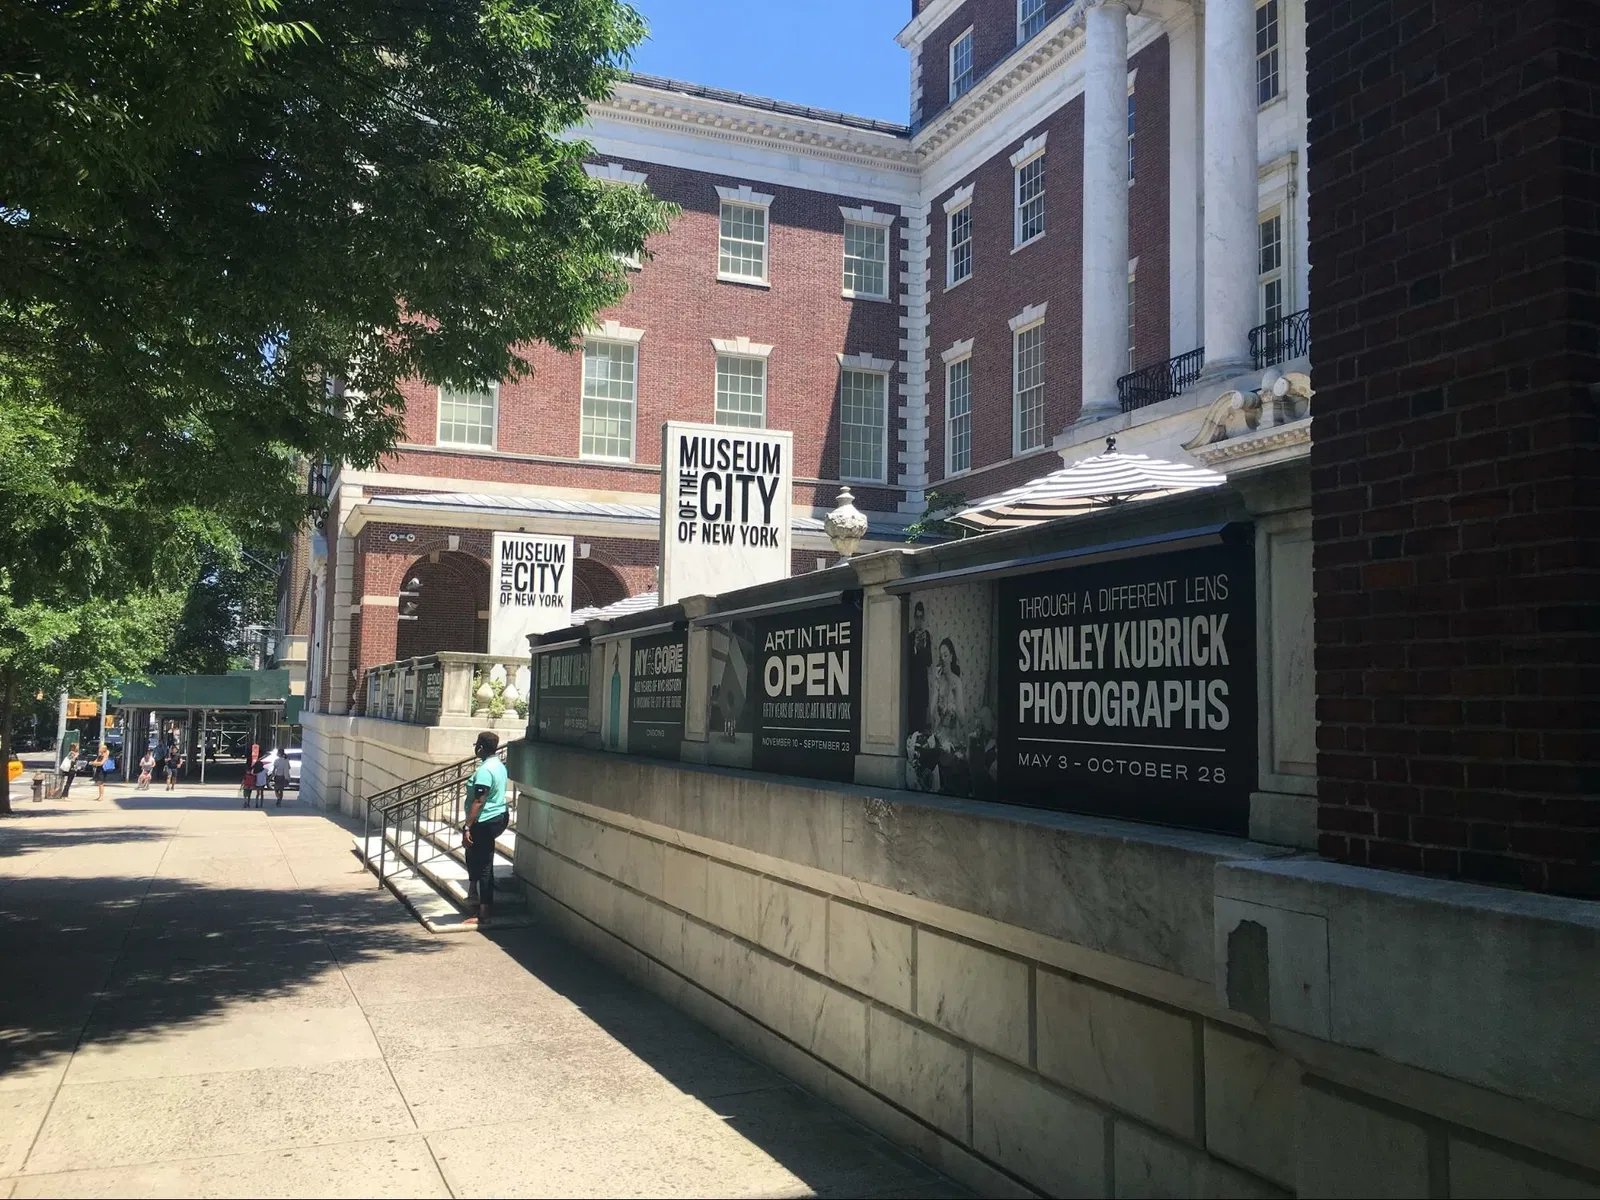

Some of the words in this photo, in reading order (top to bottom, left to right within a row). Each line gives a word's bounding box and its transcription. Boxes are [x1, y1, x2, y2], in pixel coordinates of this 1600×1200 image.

[680, 436, 780, 474] MUSEUM
[680, 470, 698, 496] THE
[700, 472, 780, 525] CITY
[679, 500, 697, 519] OF
[678, 522, 697, 542] OF
[702, 523, 735, 545] NEW
[740, 525, 779, 547] YORK
[501, 541, 566, 563] MUSEUM
[501, 561, 513, 578] THE
[501, 579, 512, 591] OF
[514, 562, 565, 593] CITY
[500, 592, 512, 606] OF
[515, 593, 536, 607] NEW
[539, 594, 564, 608] YORK
[1019, 592, 1076, 619] THROUGH
[1082, 591, 1092, 614] A
[1100, 580, 1177, 612] DIFFERENT
[1185, 573, 1229, 604] LENS
[764, 629, 796, 652] ART
[797, 627, 812, 649] IN
[815, 621, 851, 646] THE
[1018, 623, 1109, 672] STANLEY
[1114, 613, 1230, 669] KUBRICK
[634, 649, 649, 676] NY
[654, 643, 683, 674] CORE
[764, 650, 850, 697] OPEN
[775, 702, 787, 718] YEARS
[794, 702, 809, 719] PUBLIC
[810, 702, 820, 719] ART
[820, 702, 826, 719] IN
[826, 702, 837, 719] NEW
[838, 702, 851, 719] YORK
[1019, 679, 1230, 731] PHOTOGRAPHS
[762, 737, 791, 747] NOVEMBER
[792, 739, 798, 748] 10
[803, 739, 840, 751] SEPTEMBER
[841, 742, 850, 752] 23
[1018, 753, 1052, 768] MAY
[1058, 755, 1068, 769] 3
[1087, 757, 1189, 781] OCTOBER
[1198, 766, 1226, 784] 28
